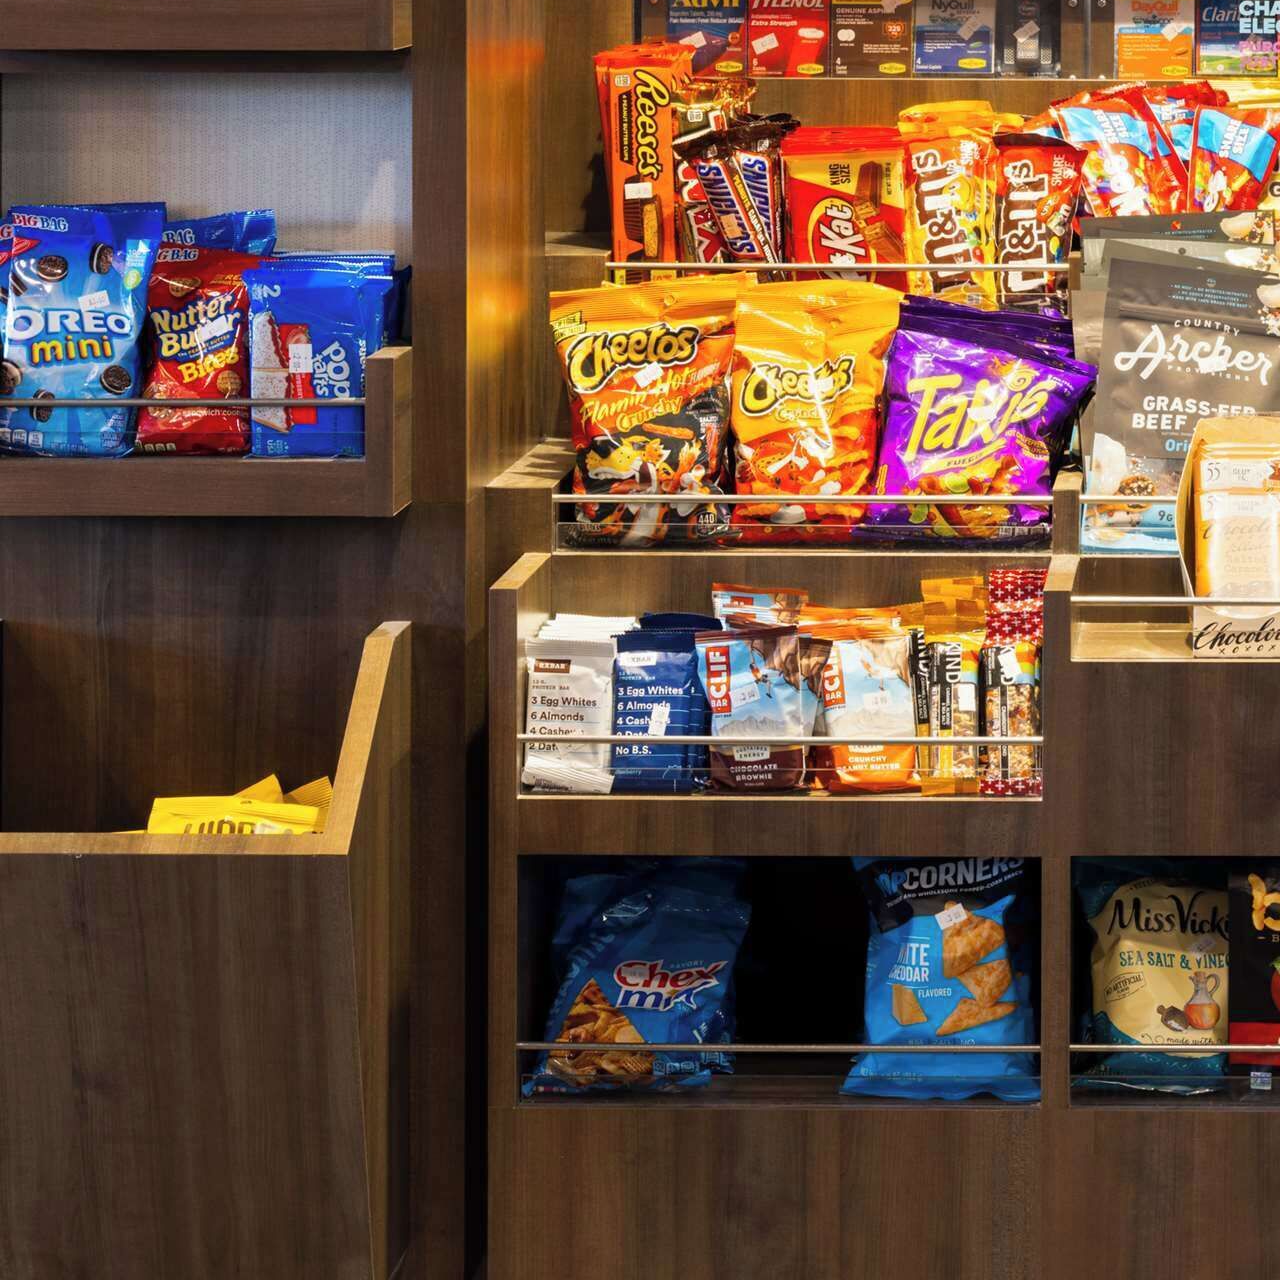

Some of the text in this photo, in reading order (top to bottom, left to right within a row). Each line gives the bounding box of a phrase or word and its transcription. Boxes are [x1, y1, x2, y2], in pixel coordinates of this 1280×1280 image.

[931, 0, 975, 13] NyQuil
[634, 70, 671, 181] Reese's
[829, 163, 840, 186] KING
[840, 163, 851, 185] SIZE
[1051, 153, 1066, 187] SHARE
[6, 308, 132, 342] OREO
[150, 292, 235, 336] Nutter
[1173, 318, 1241, 337] COUNTRY
[30, 334, 113, 366] mini
[177, 343, 240, 385] Bites
[565, 322, 701, 393] Cheetos
[1113, 324, 1274, 386] Archer
[903, 366, 1056, 462] Takis
[1131, 412, 1188, 431] BEEF
[709, 651, 728, 699] CLIF
[945, 643, 963, 684] KIND
[530, 696, 598, 708] 3 Egg Whites
[617, 685, 684, 699] 3 Egg Whites
[530, 710, 586, 723] 6 Almonds
[615, 745, 653, 756] No B.S.
[735, 772, 774, 782] BROWNIE
[1107, 897, 1176, 936] Miss
[614, 960, 728, 991] Chex
